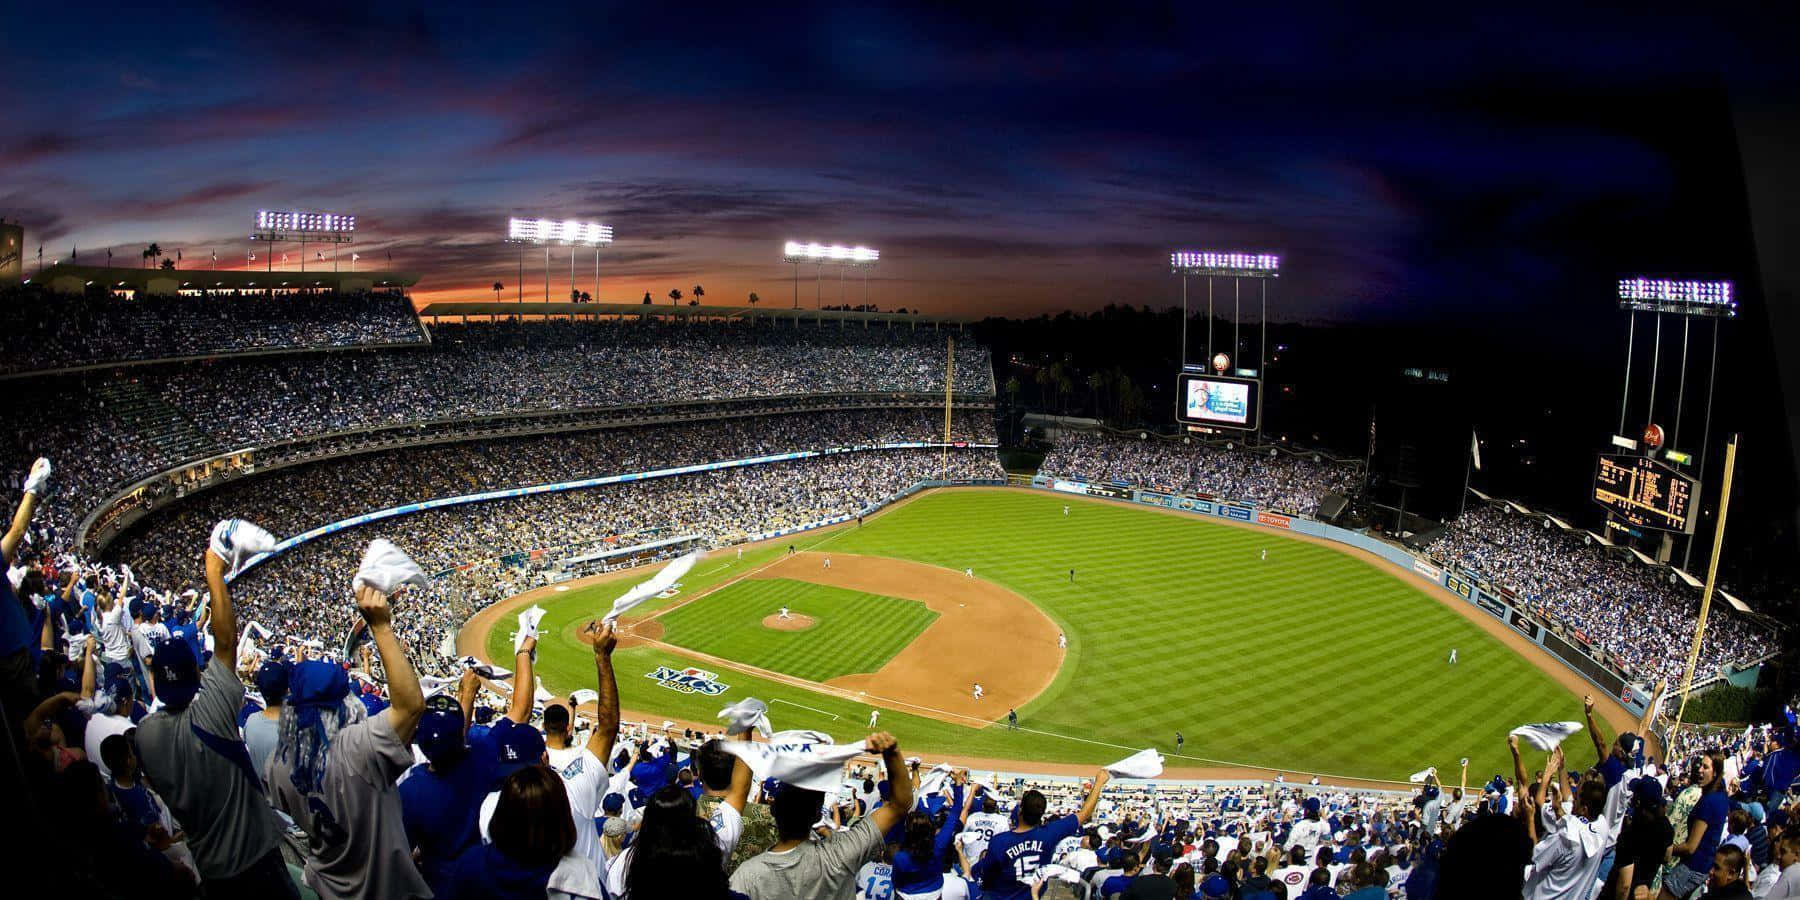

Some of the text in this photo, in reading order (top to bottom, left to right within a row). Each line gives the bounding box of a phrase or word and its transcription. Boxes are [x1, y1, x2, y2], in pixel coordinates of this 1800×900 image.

[1267, 517, 1289, 526] TOYOTA
[646, 667, 728, 695] NLCS
[504, 744, 518, 759] LA
[1006, 840, 1043, 860] FURCAL
[1014, 855, 1041, 879] 15
[865, 876, 894, 900] 13
